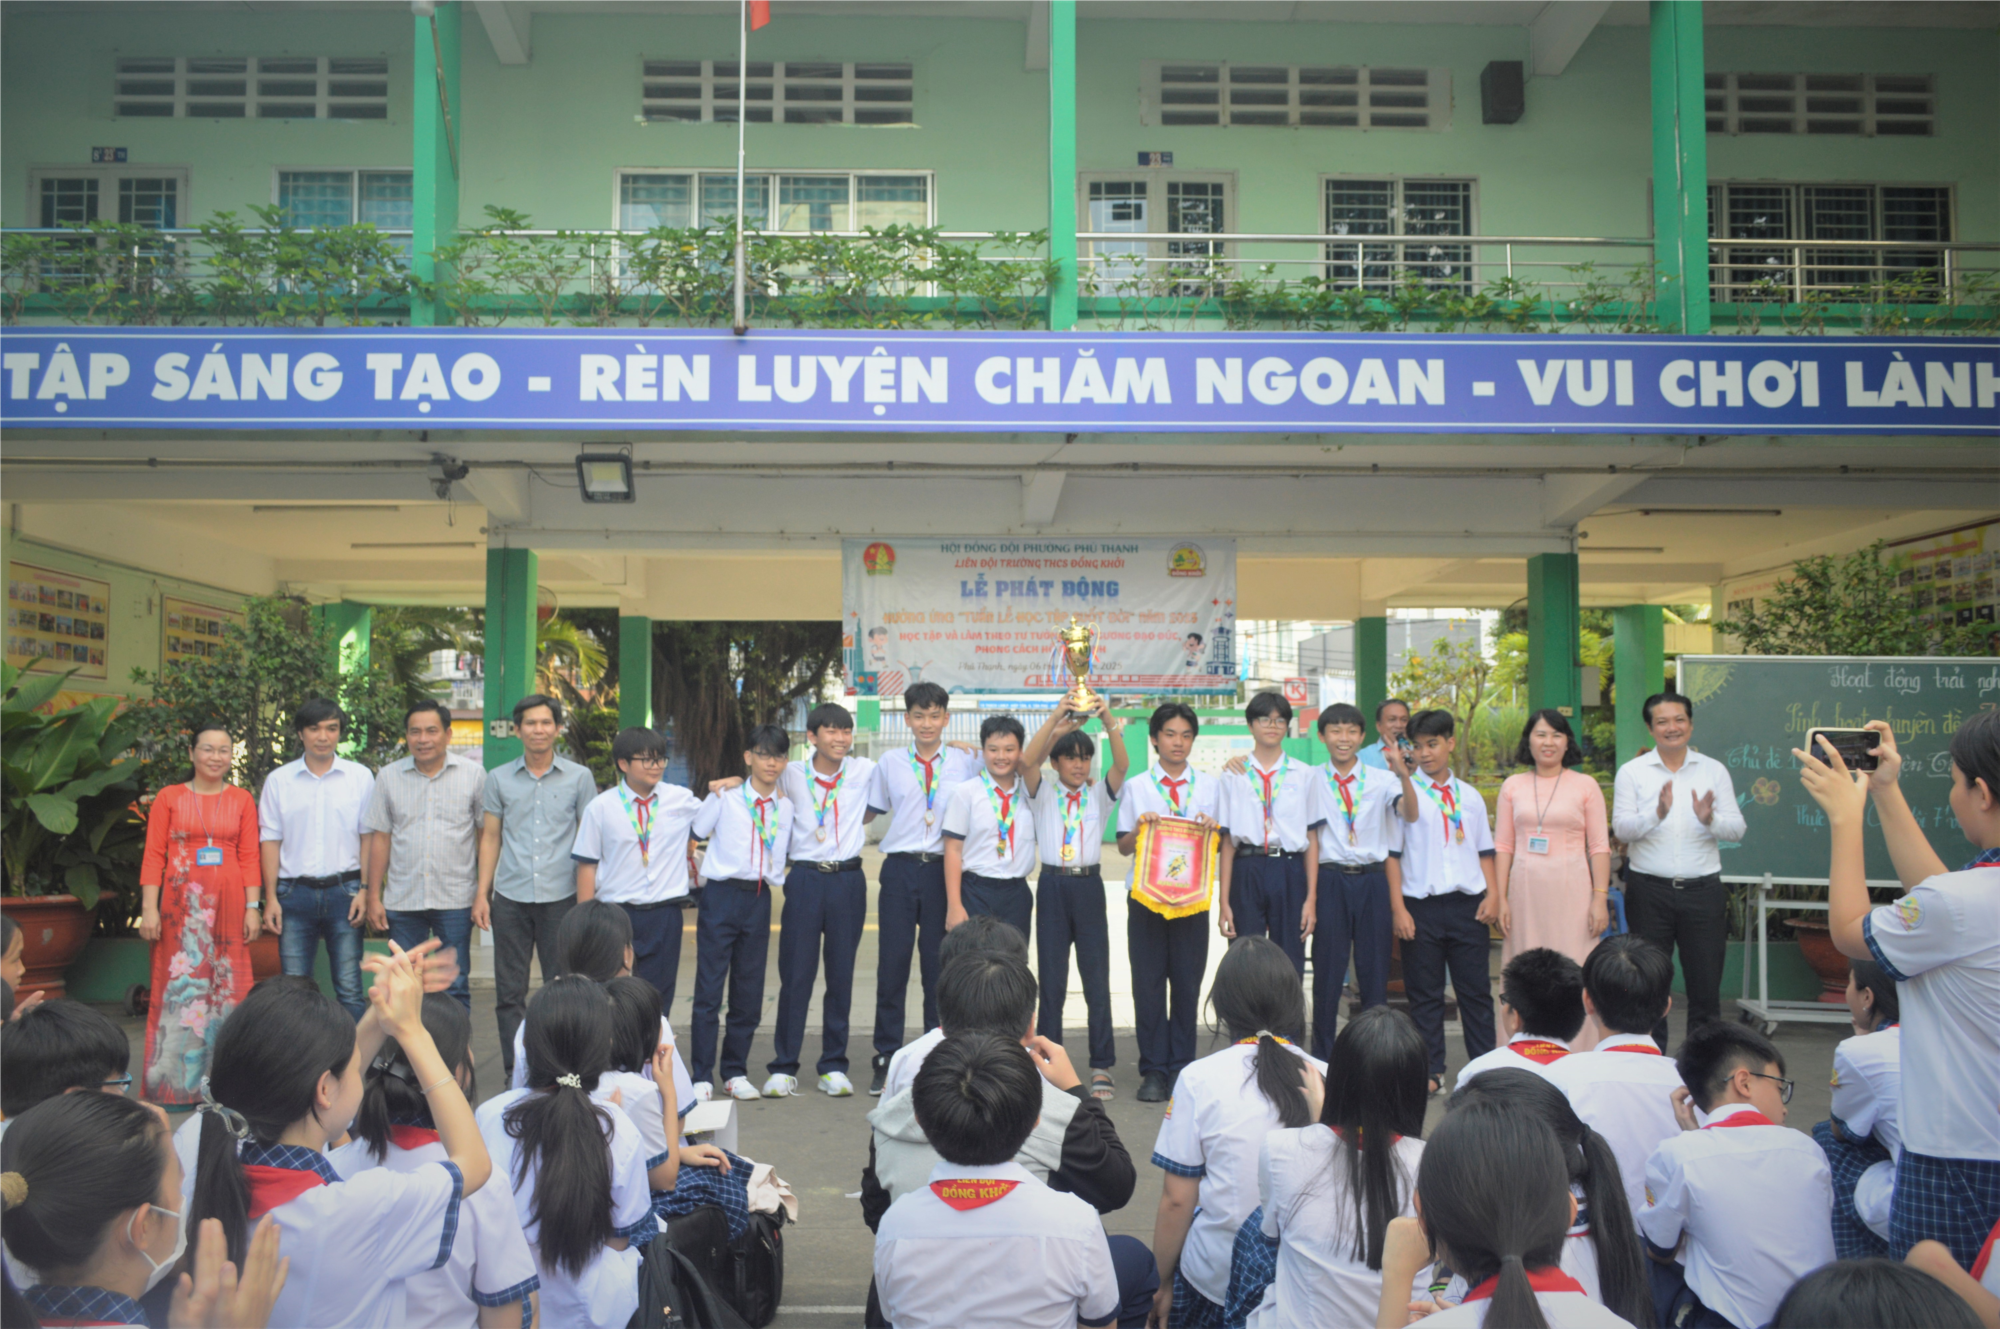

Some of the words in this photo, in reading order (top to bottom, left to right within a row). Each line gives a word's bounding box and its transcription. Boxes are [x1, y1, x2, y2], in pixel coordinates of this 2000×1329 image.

[4, 342, 130, 413] TẬP
[151, 342, 343, 402] SÁNG
[366, 352, 501, 413] TẠO
[579, 343, 711, 402] RÈN
[737, 344, 949, 416] LUYỆN
[974, 347, 1172, 406] CHĂM
[1195, 356, 1446, 406] NGOAN
[1517, 359, 1635, 407] VUI
[1659, 359, 1820, 408] CHƠI
[941, 542, 960, 555] HỘI
[964, 541, 996, 554] ĐỒNG
[1000, 542, 1020, 555] ĐỘI
[1023, 541, 1070, 554] PHƯỜNG
[1101, 543, 1139, 555] THẠNH
[955, 557, 977, 568] LIÊN
[980, 557, 998, 570] ĐỘI
[1000, 556, 1041, 569] TRƯỜNG
[1043, 558, 1068, 569] THCS
[1070, 554, 1099, 569] ĐỒNG
[1100, 555, 1125, 569] KHỞI
[960, 573, 988, 598] LỄ
[995, 575, 1055, 598] PHÁT
[1061, 576, 1120, 601] ĐỘNG
[1016, 611, 1044, 627] HỌC
[1045, 608, 1069, 626] TẬP
[1169, 612, 1198, 624] 2025
[899, 632, 920, 643] HỌC
[923, 629, 942, 643] TẬP
[945, 629, 958, 640] VÀ
[961, 629, 982, 640] LÀM
[985, 631, 1012, 640] THEO
[1133, 631, 1155, 643] ĐẠO
[975, 645, 1010, 654] PHONG
[1013, 642, 1039, 654] CÁCH
[1029, 661, 1042, 670] 06
[1102, 661, 1122, 671] 2025
[1884, 665, 1920, 696] động
[1933, 667, 1965, 689] trải
[942, 1184, 977, 1199] ĐỒNG
